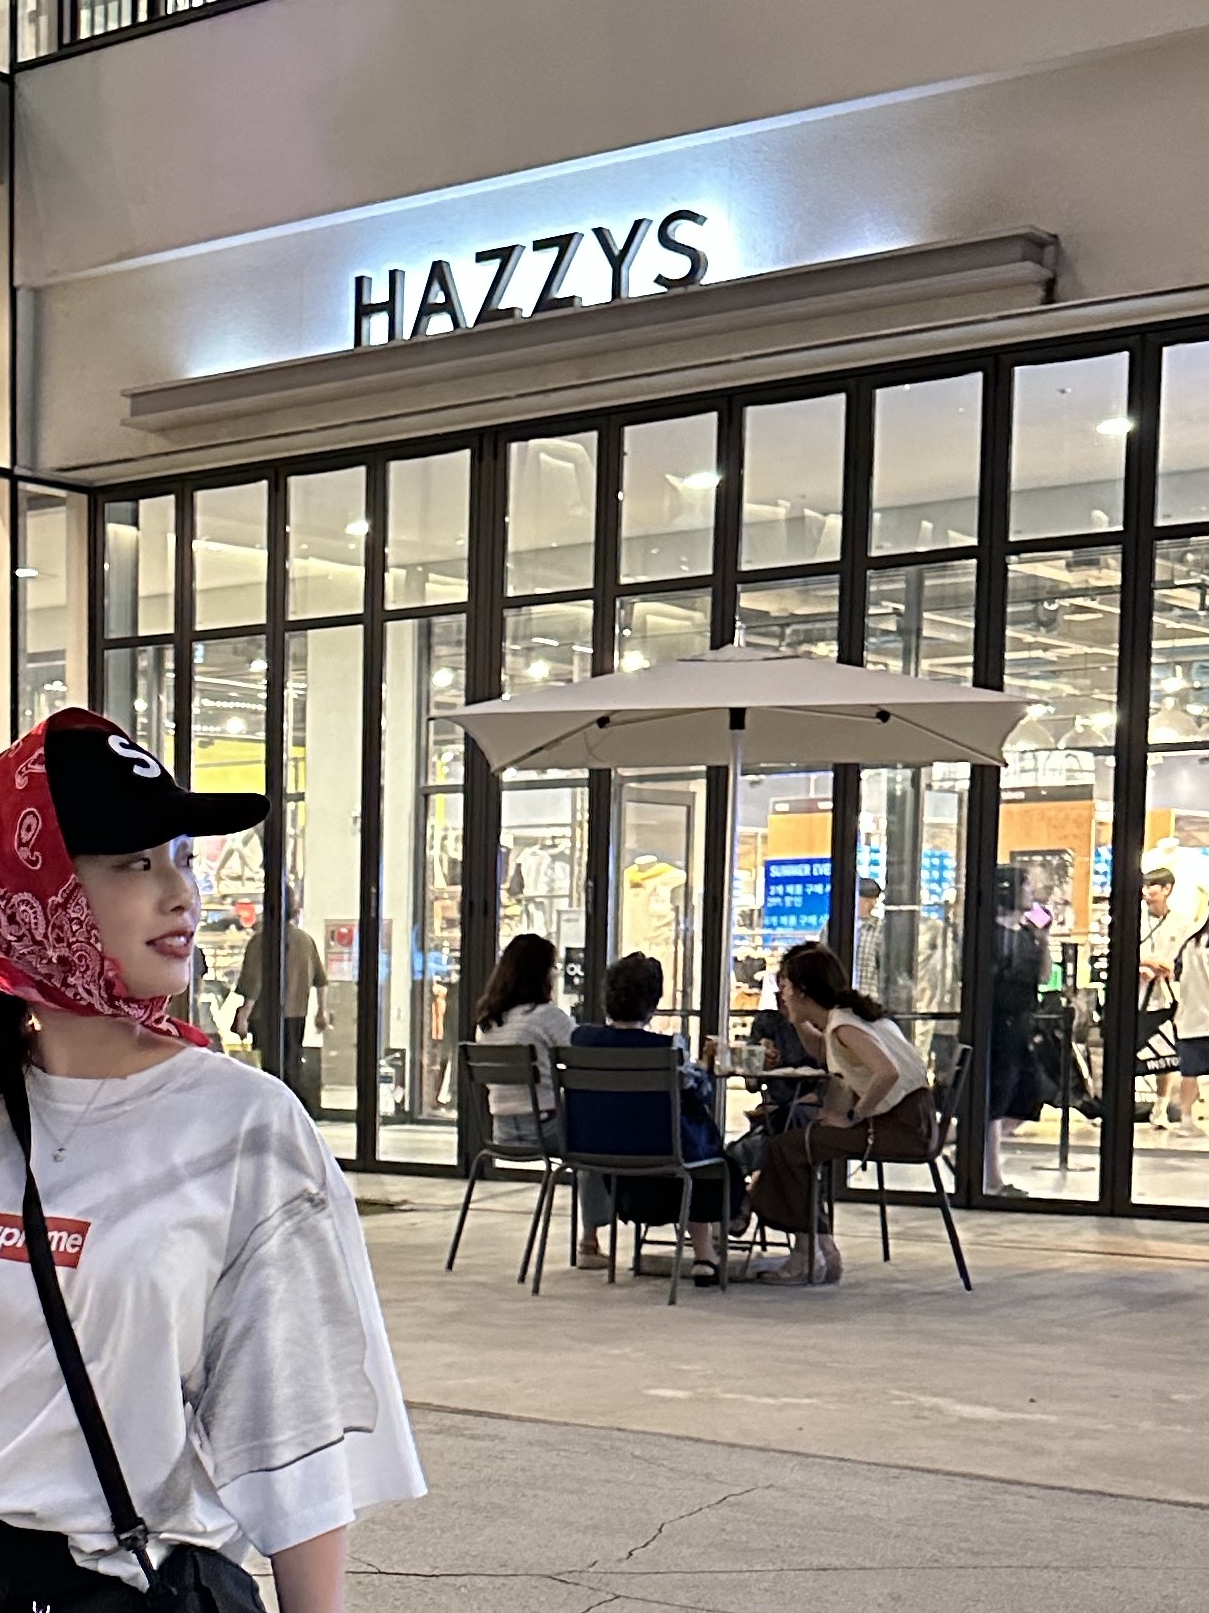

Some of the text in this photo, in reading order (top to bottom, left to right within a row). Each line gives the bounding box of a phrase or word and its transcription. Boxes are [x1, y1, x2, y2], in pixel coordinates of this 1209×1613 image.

[354, 208, 709, 348] HAZZYS
[107, 734, 162, 778] S
[812, 863, 831, 876] EVE
[1146, 1056, 1180, 1070] INSTO
